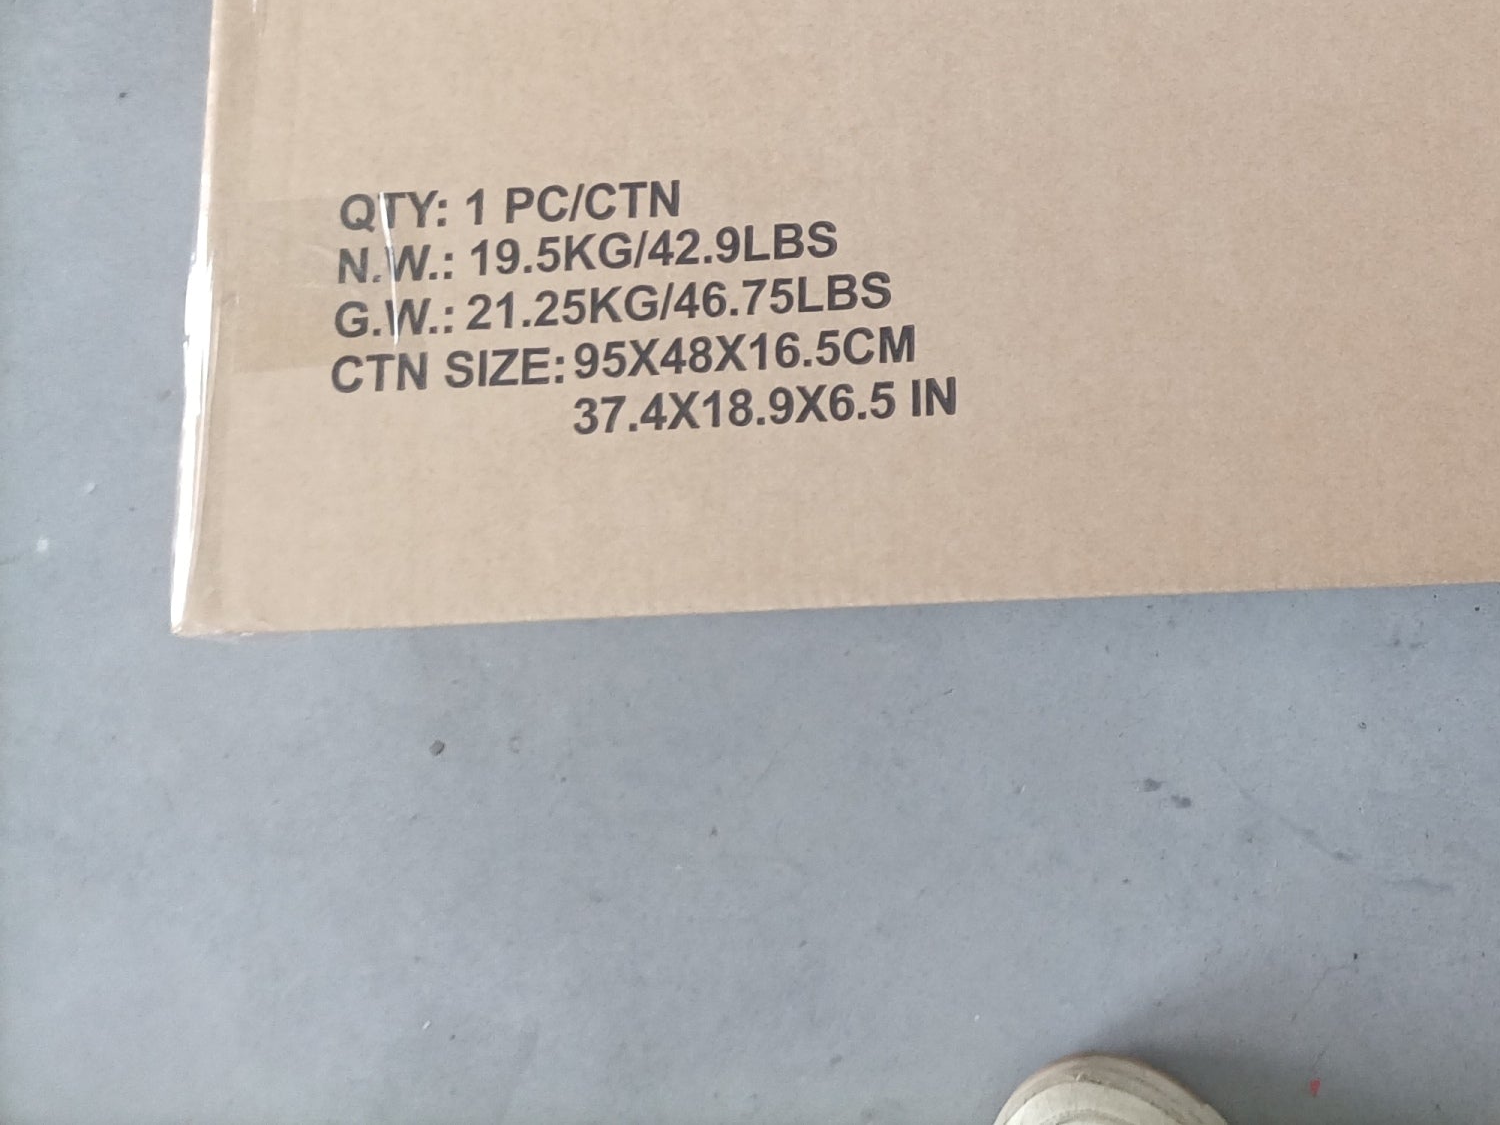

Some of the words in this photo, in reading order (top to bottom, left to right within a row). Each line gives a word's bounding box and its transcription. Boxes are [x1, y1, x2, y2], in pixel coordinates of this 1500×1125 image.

[339, 189, 448, 233] QTY:
[466, 187, 485, 226] 1
[505, 179, 681, 224] PC/CTN
[337, 244, 454, 285] N.W.:
[470, 220, 839, 276] 19.5KG/42.9LBS
[334, 297, 454, 339] G.W.:
[465, 270, 893, 331] 21.25KG/46.75LBS
[331, 351, 428, 394] CTN
[574, 324, 915, 380] 95X48X16.5CM
[573, 380, 896, 435] 37.4X18.9X6.5
[911, 376, 957, 417] IN
